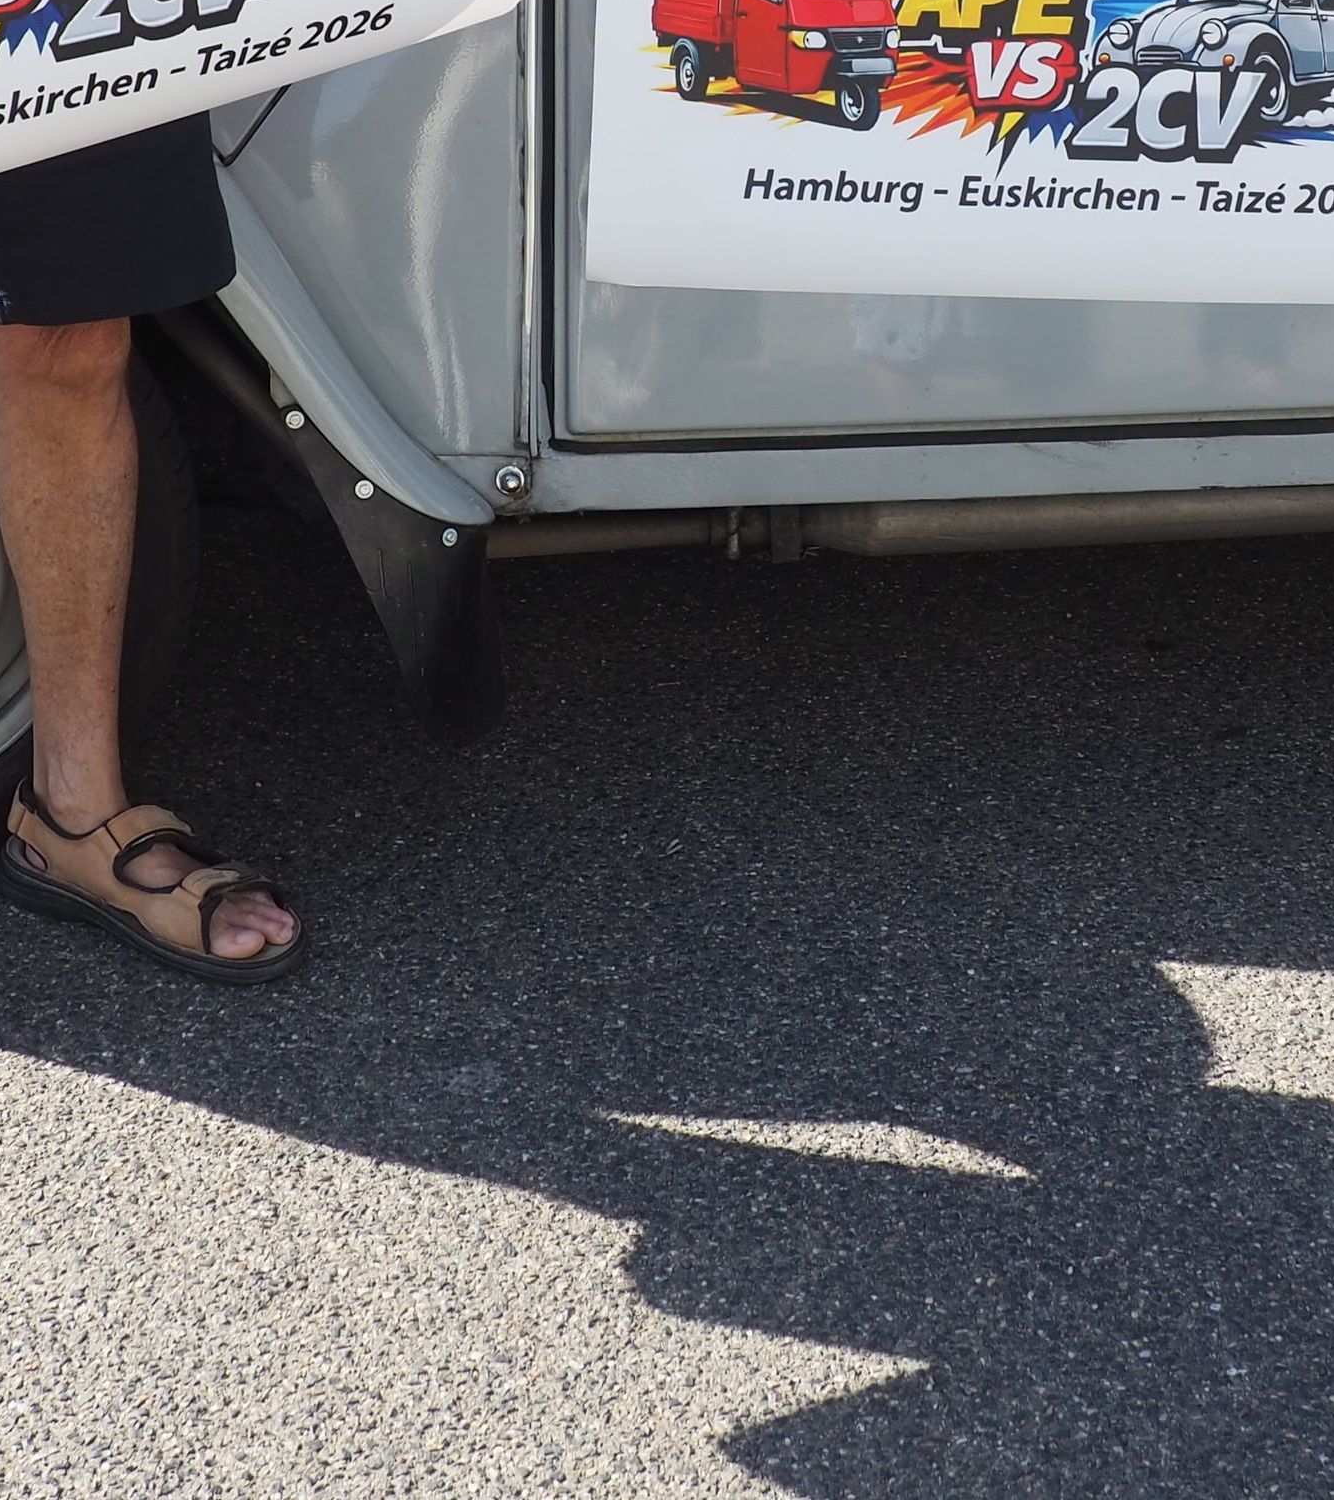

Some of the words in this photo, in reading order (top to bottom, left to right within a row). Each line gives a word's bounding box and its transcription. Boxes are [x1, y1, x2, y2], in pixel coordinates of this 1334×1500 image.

[196, 26, 294, 77] Taizé
[298, 2, 396, 51] 2026
[970, 40, 1063, 100] VS
[1071, 66, 1267, 151] 2CV
[742, 167, 925, 213] Hamburg
[958, 174, 1161, 212] Euskirchen
[1195, 180, 1288, 214] Taizé
